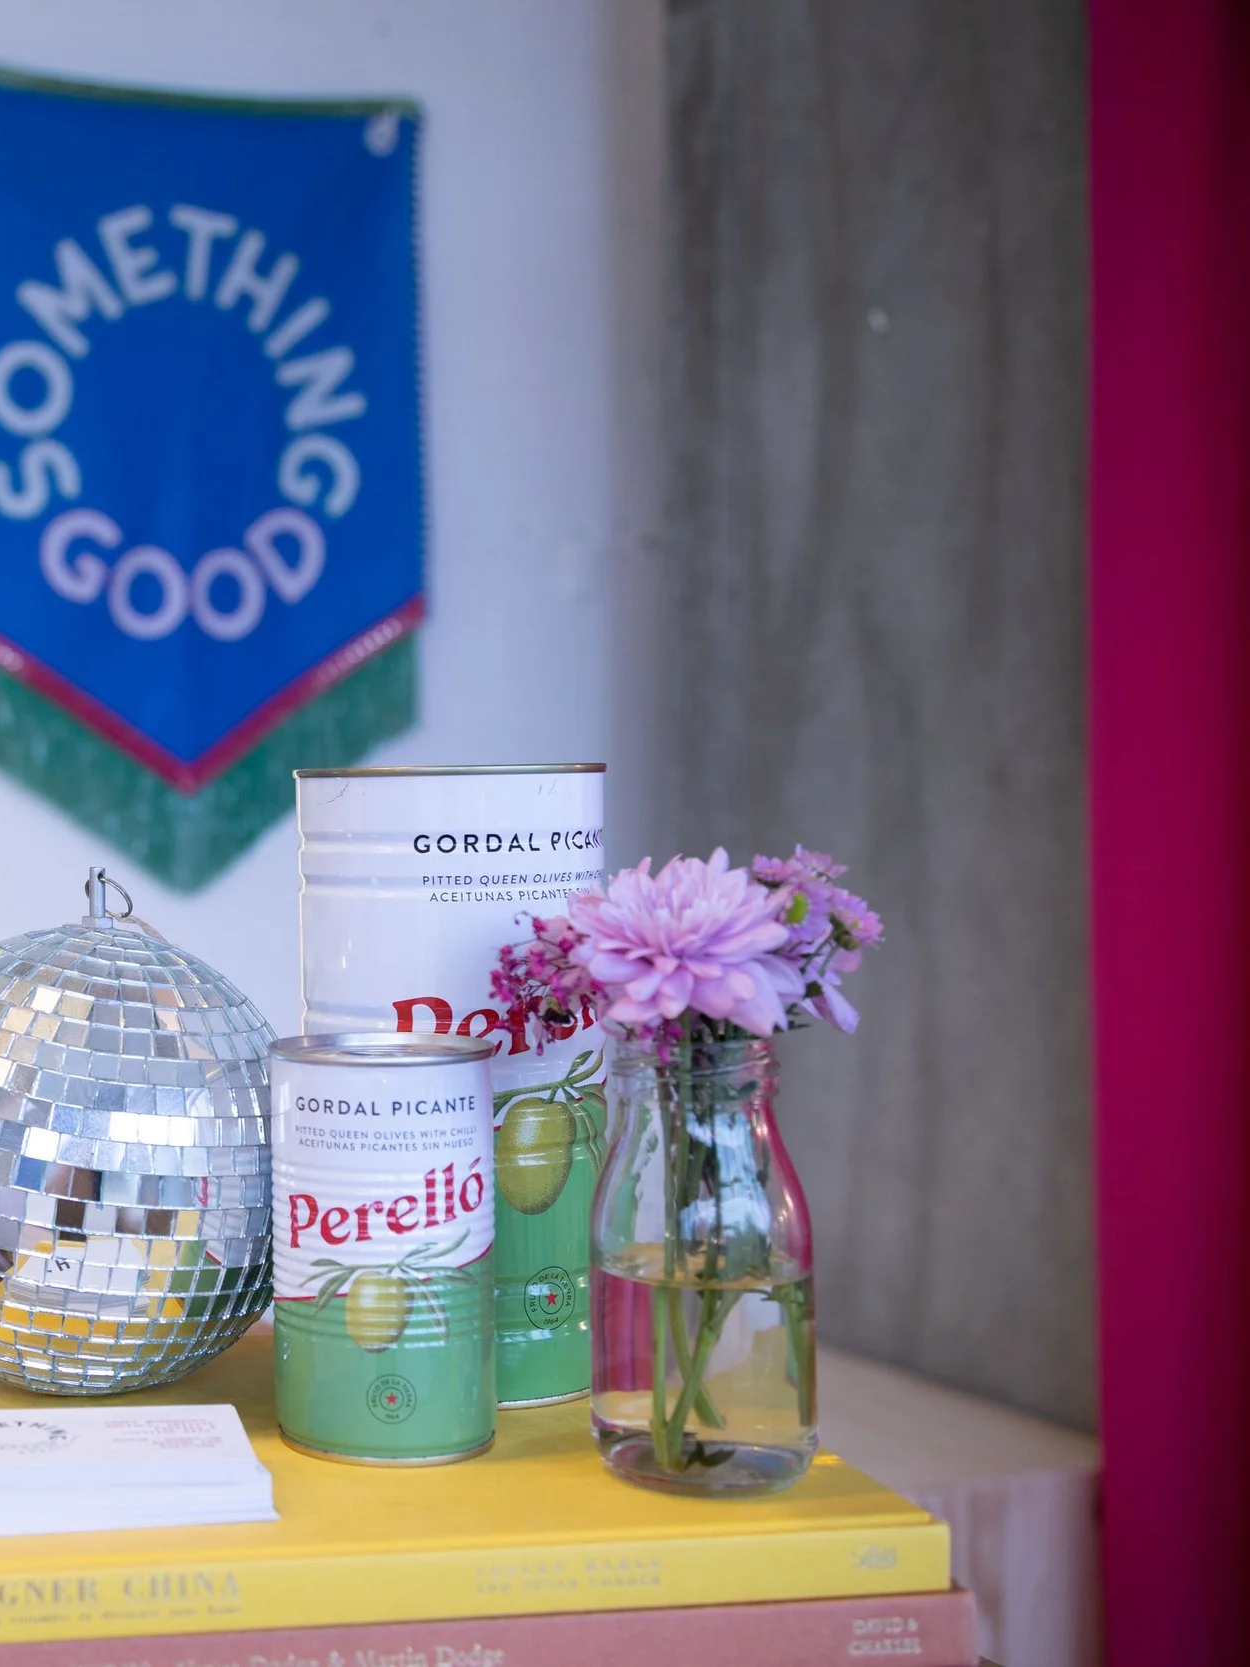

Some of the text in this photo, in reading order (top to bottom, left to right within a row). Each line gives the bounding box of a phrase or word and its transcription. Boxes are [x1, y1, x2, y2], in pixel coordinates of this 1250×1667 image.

[40, 507, 327, 641] GOOD
[413, 833, 541, 854] GORDAL
[422, 875, 473, 886] PITTED
[479, 873, 528, 887] QUEEN
[533, 872, 572, 884] OLIVES
[429, 891, 514, 902] ACEITUNAS
[518, 888, 573, 901] PICANTE
[295, 1095, 476, 1117] GORDAL PICANTE
[295, 1124, 326, 1138] PITTED
[329, 1128, 369, 1140] QUEEN
[373, 1130, 416, 1141] OLIVES
[420, 1128, 447, 1140] WITH
[299, 1137, 474, 1152] ACEITUNAS PICANTES SIN HUESO
[288, 1157, 484, 1249] Perelló
[122, 1571, 242, 1601] CHINA
[436, 1642, 505, 1667] Dodge
